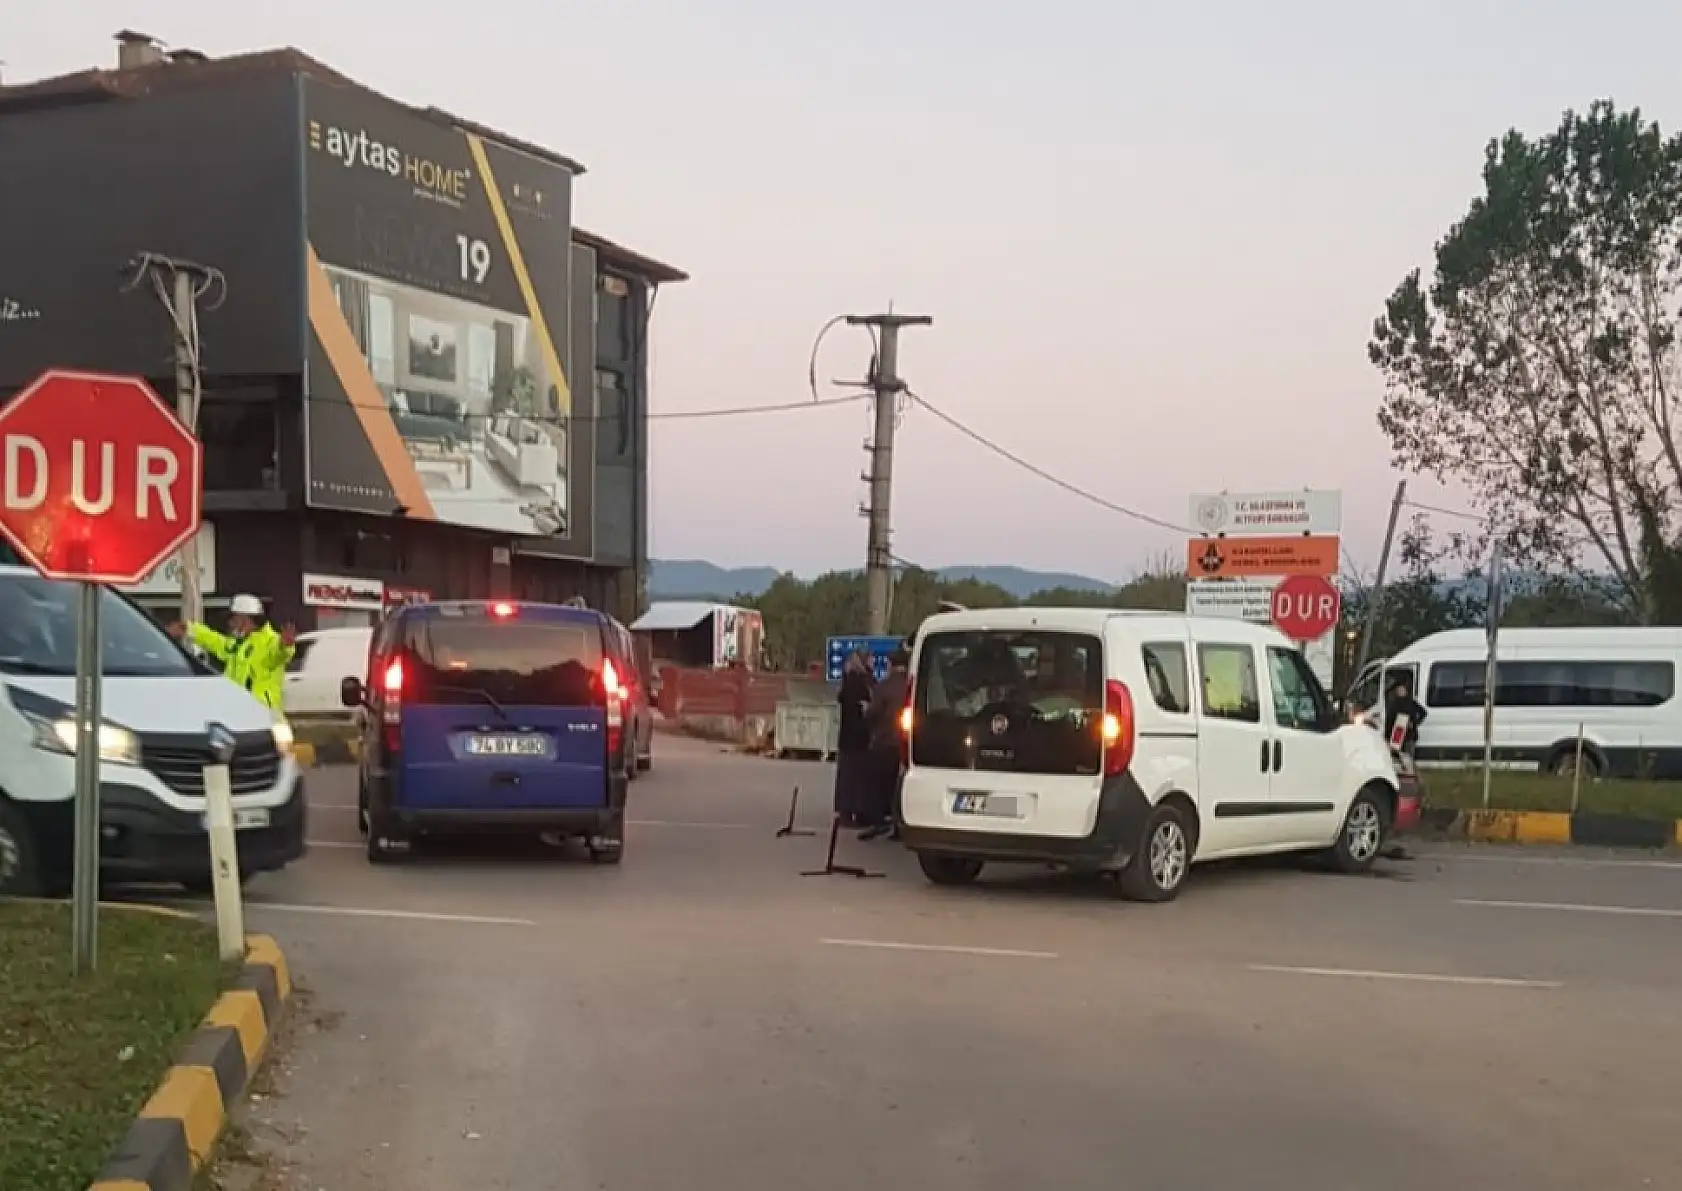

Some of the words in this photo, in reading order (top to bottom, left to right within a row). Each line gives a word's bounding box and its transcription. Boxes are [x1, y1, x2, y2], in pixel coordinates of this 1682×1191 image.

[404, 154, 466, 199] HOME
[456, 234, 491, 284] 19
[5, 433, 178, 522] DUR
[1277, 593, 1334, 620] DUR
